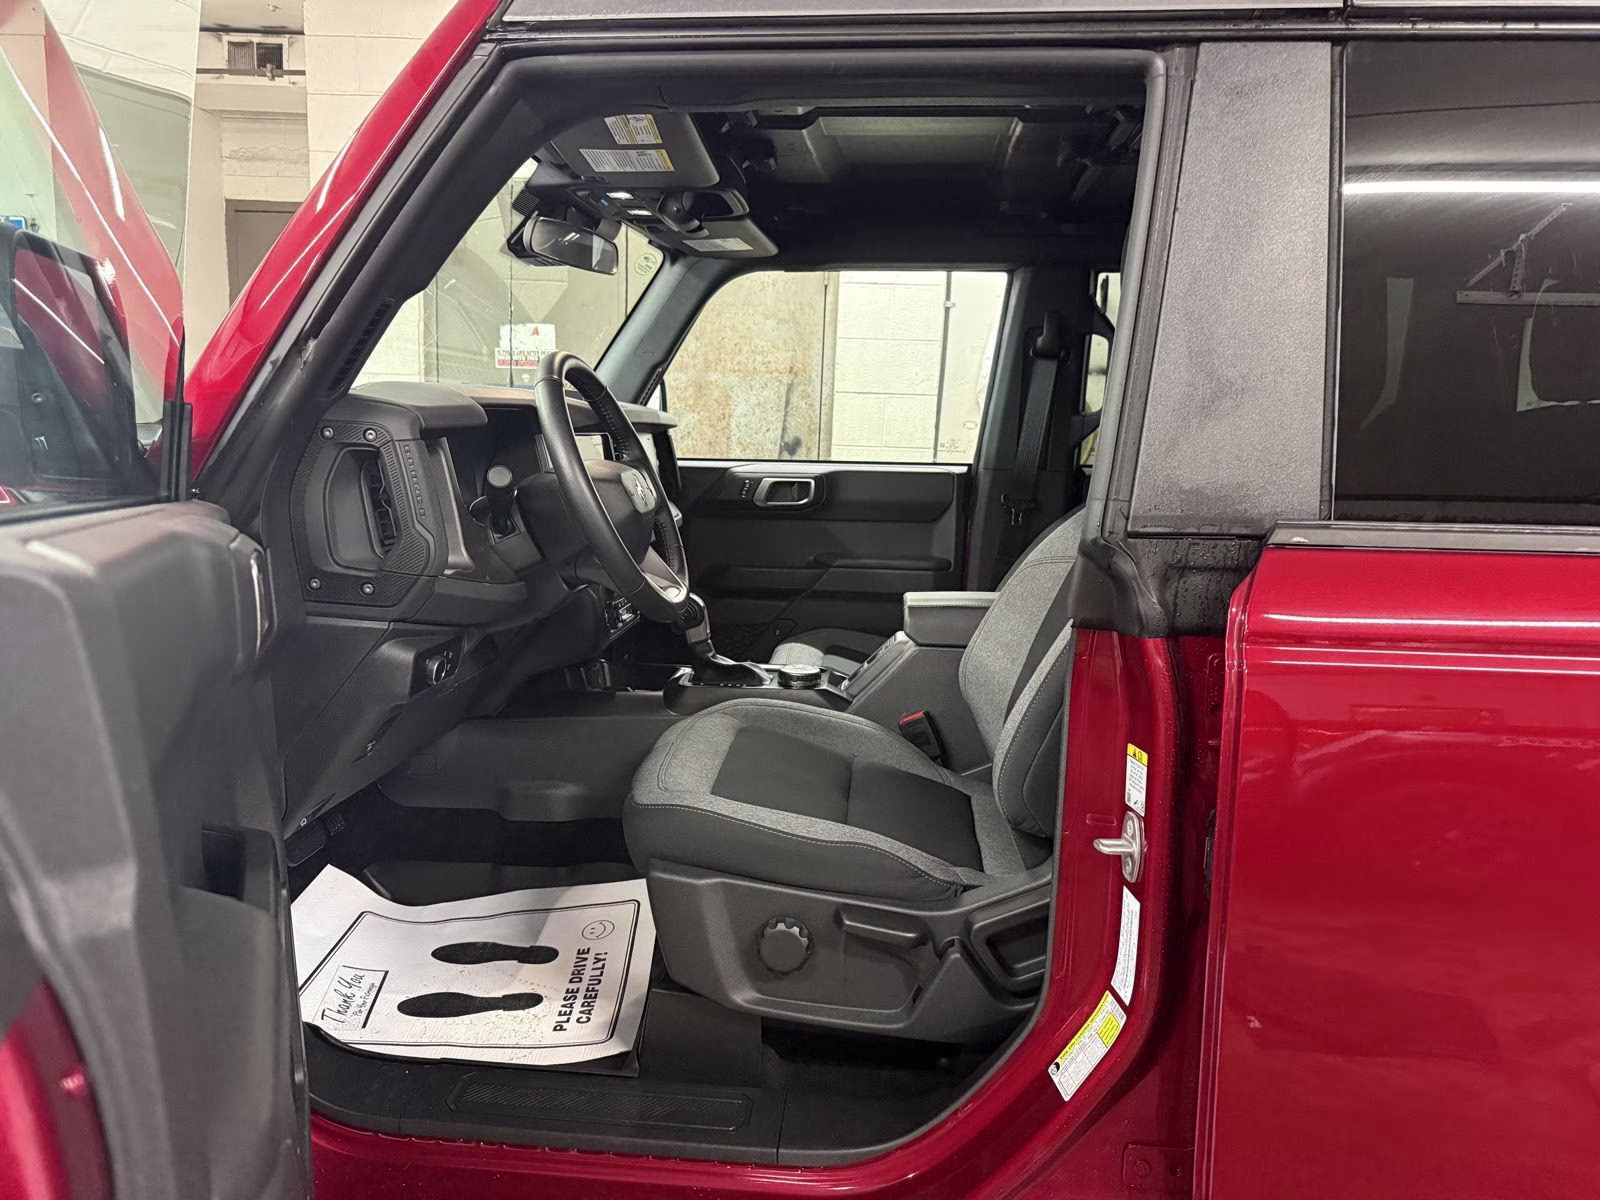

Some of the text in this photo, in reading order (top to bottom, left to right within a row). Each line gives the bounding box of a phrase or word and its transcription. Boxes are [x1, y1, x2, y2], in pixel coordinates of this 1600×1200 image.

[321, 973, 365, 1023] Thank You
[552, 947, 591, 1032] PLEASE DRIVE
[576, 952, 608, 1025] CAREFULLY!
